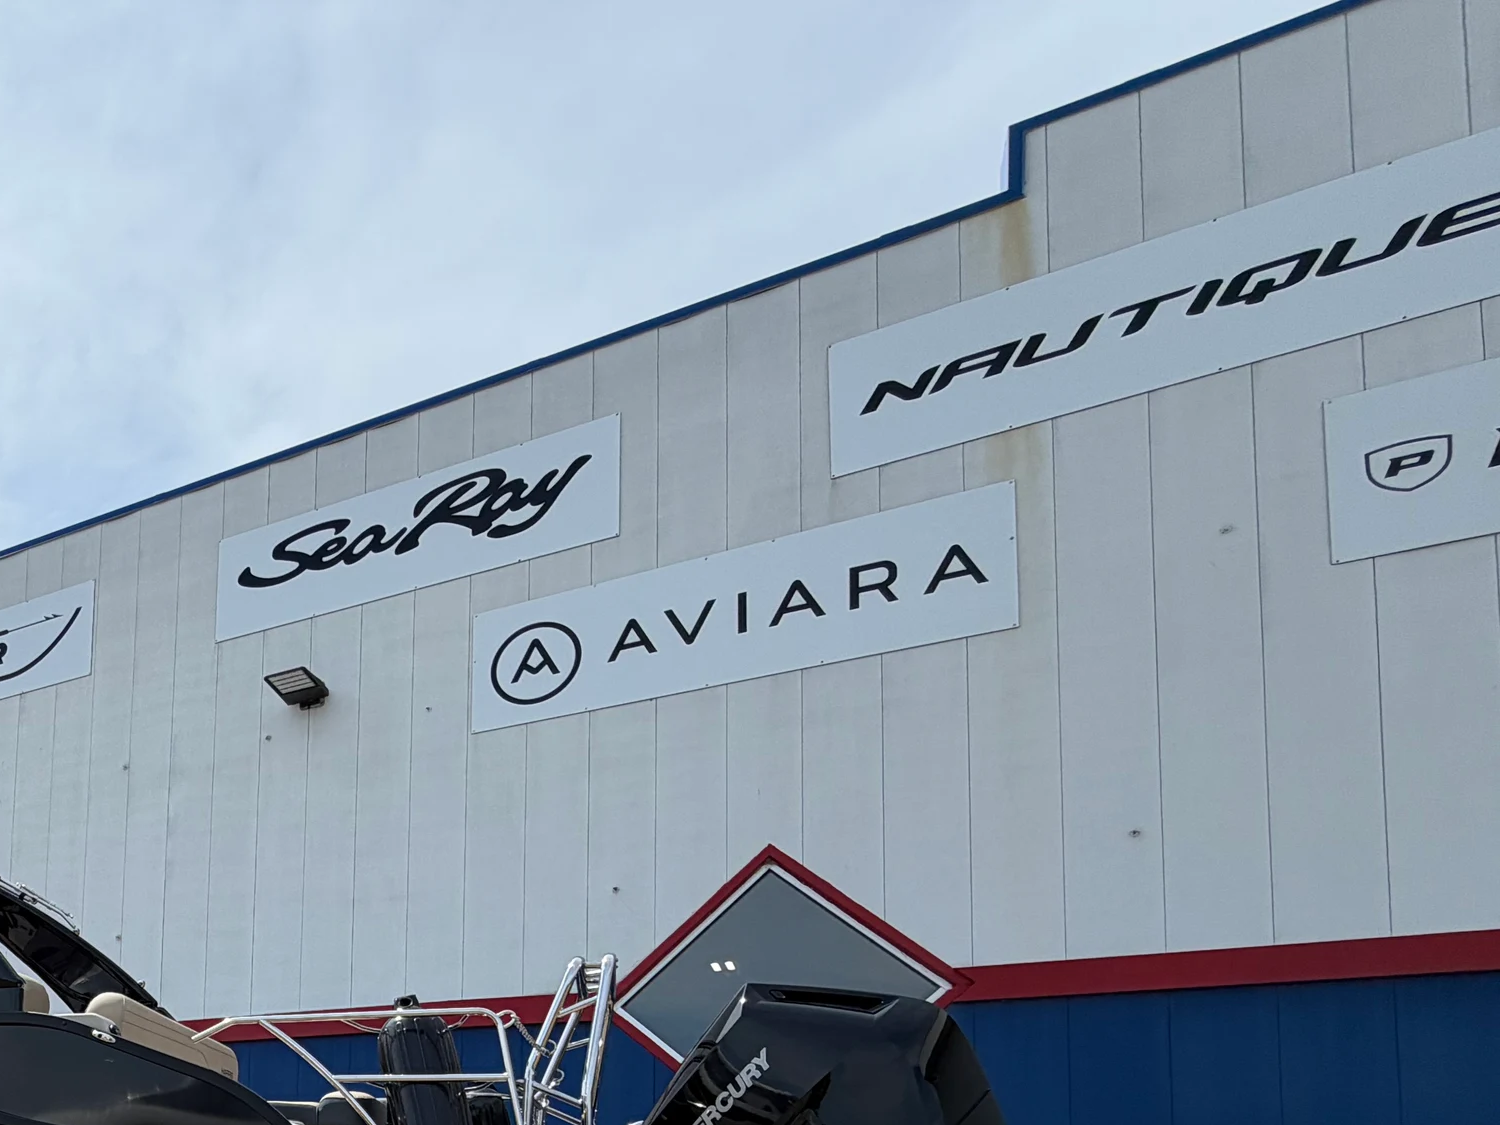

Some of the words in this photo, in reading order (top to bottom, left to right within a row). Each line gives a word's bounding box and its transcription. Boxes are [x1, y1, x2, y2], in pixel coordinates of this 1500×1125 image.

[860, 191, 1500, 416] NAUTIQUE
[238, 518, 407, 588] Sea
[395, 454, 592, 556] Ray
[607, 544, 989, 663] AVIARA
